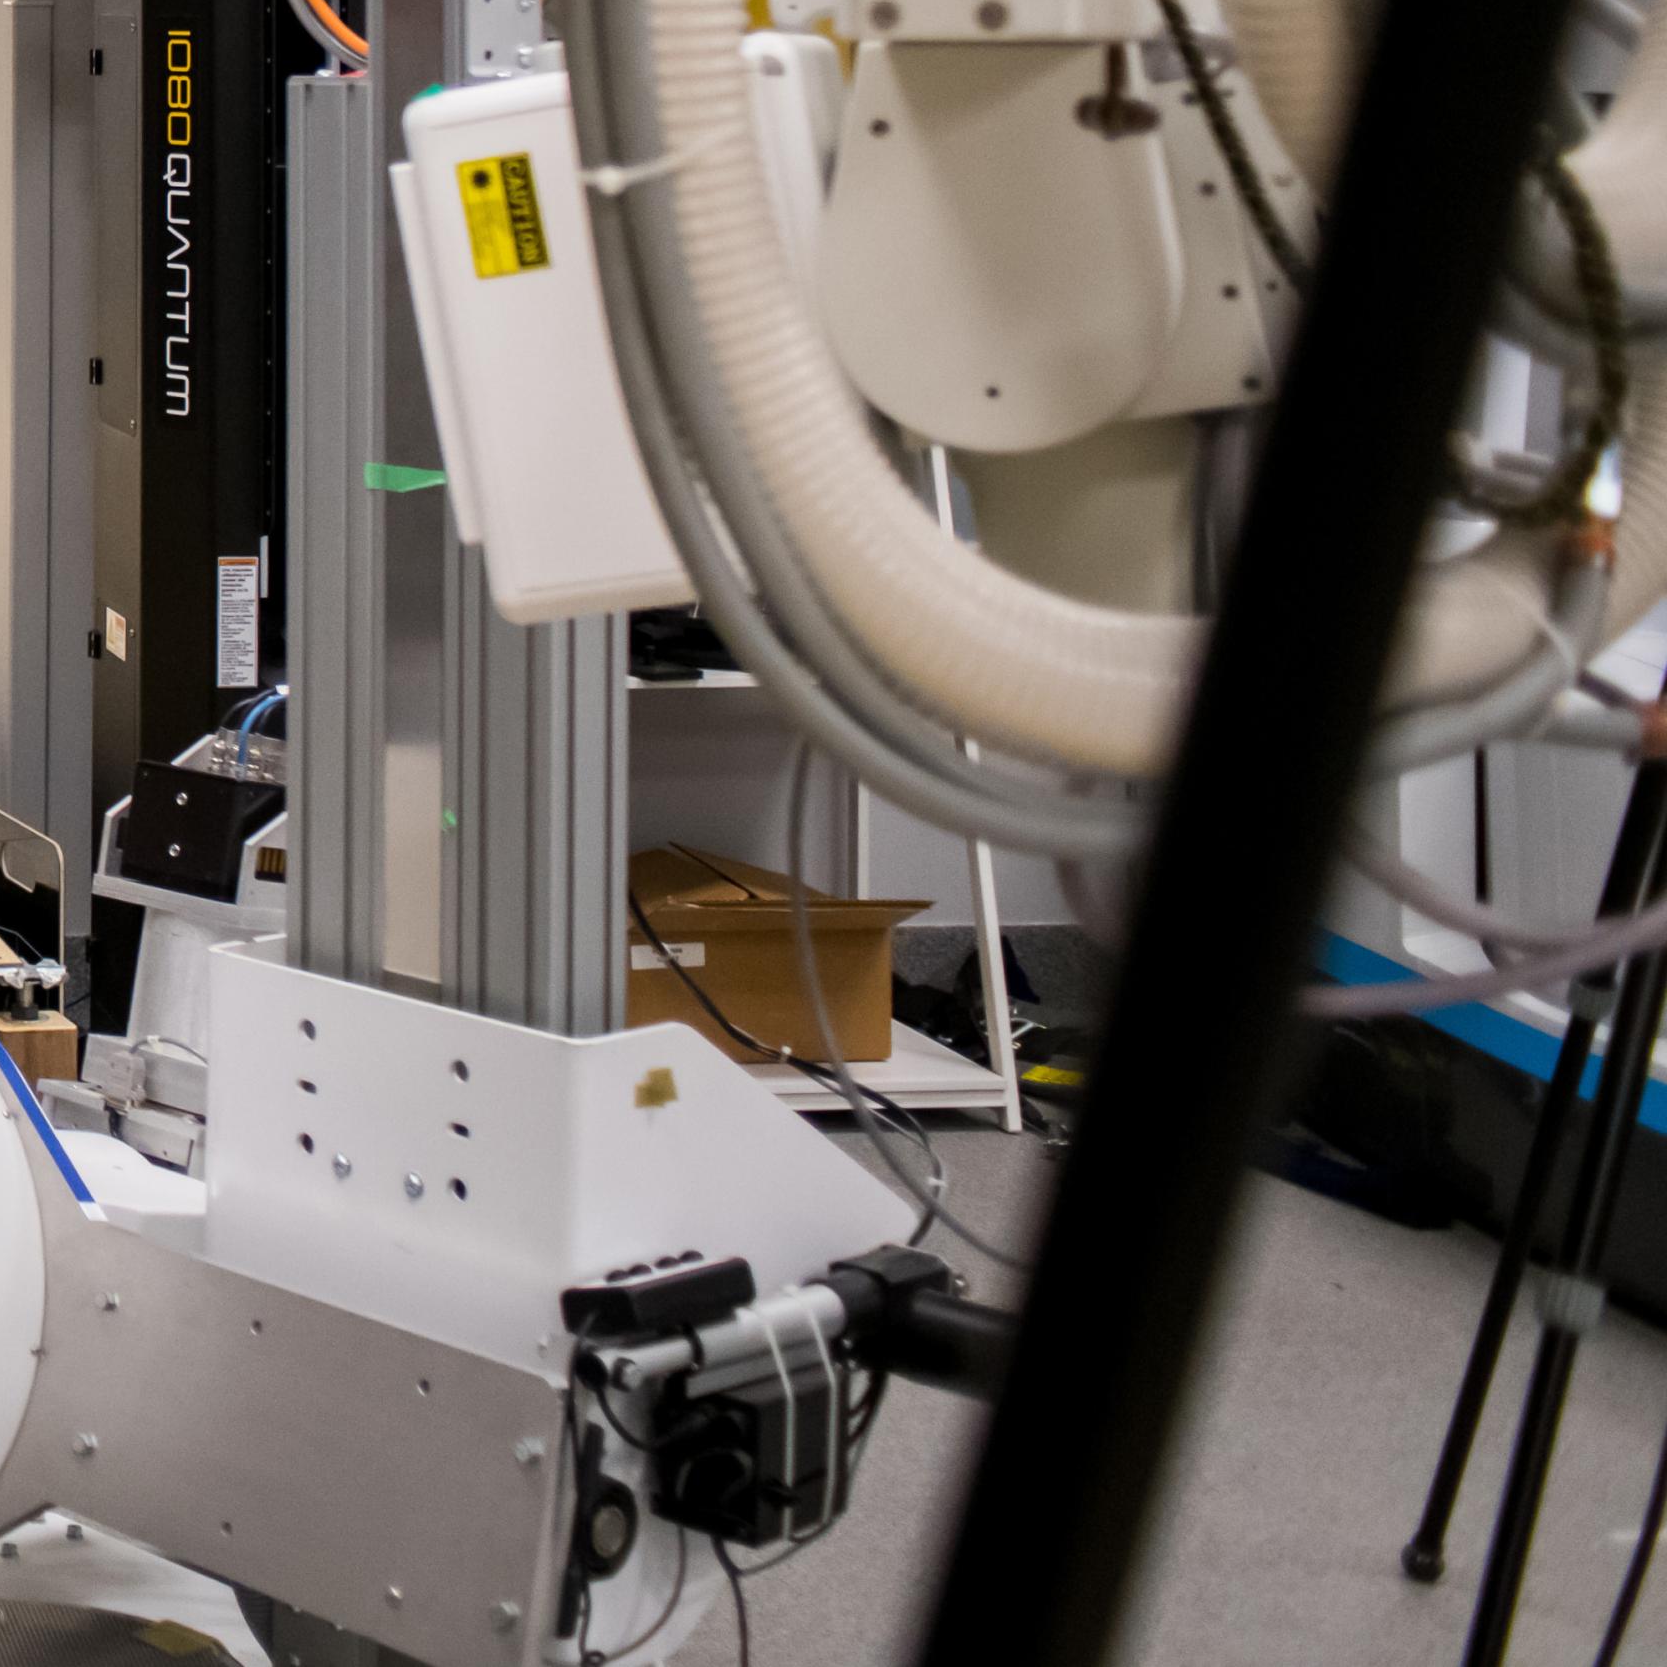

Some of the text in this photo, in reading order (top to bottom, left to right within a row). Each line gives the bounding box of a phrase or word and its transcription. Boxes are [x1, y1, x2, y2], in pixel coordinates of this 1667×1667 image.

[162, 30, 192, 416] 1080 QUANTUM
[506, 161, 541, 263] CAUTION
